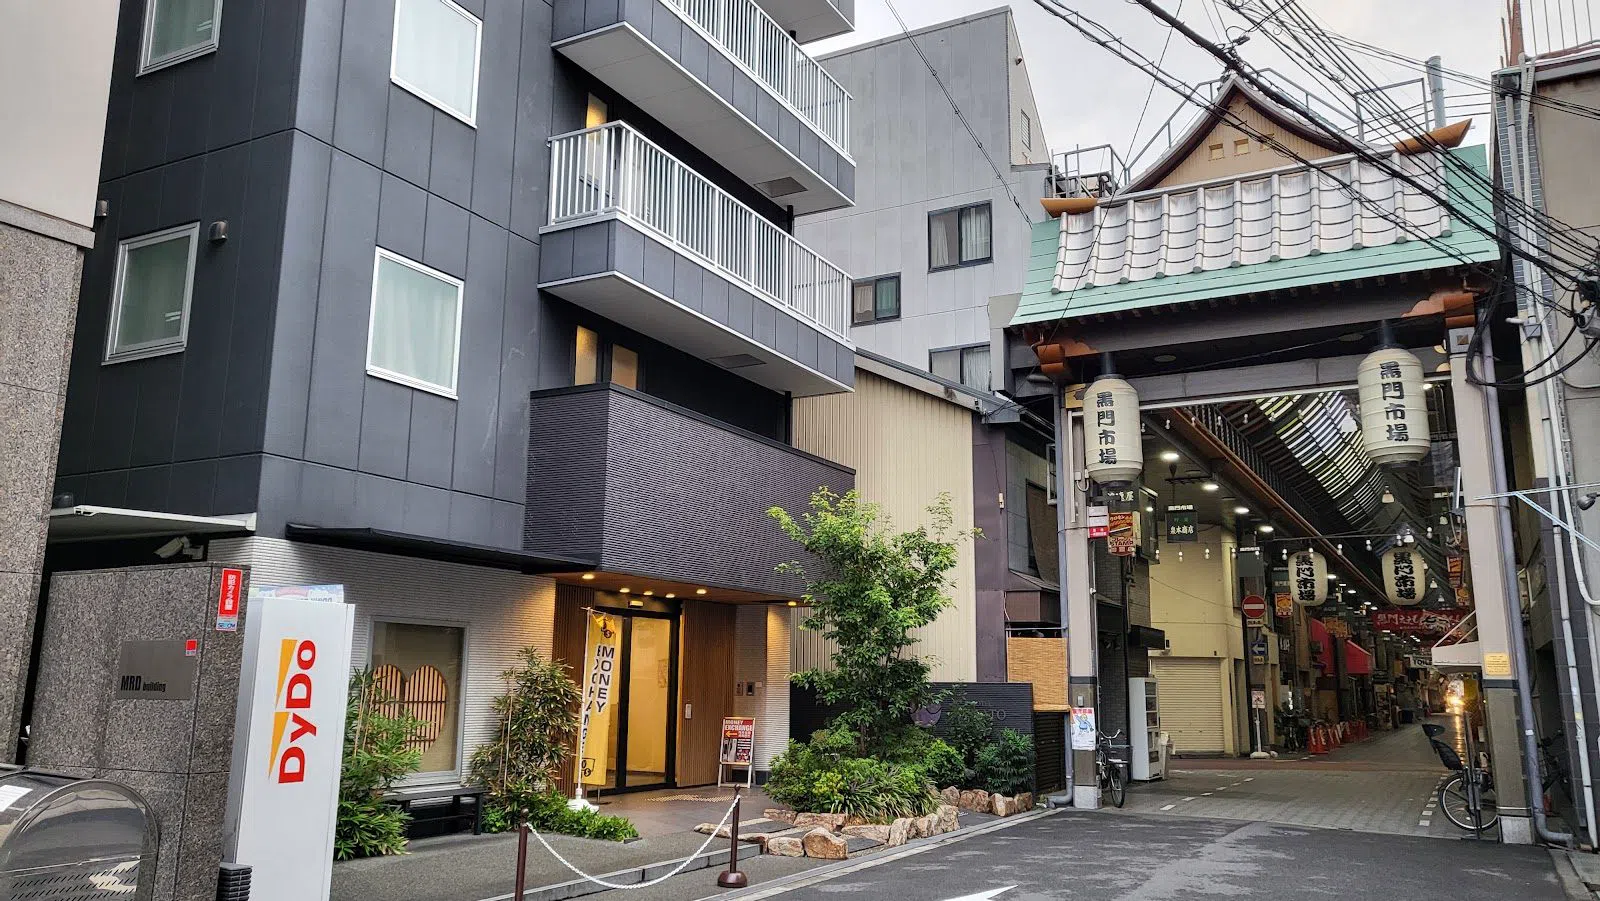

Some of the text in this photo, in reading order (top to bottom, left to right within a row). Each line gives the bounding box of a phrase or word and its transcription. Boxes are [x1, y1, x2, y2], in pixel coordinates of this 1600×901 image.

[1097, 391, 1117, 465] 黒門市場
[1380, 360, 1409, 442] 黒門市場
[1296, 555, 1316, 601] 黒門市場
[1393, 551, 1416, 599] 黒門市場
[121, 675, 167, 692] MRD building
[278, 640, 317, 784] DyDo
[596, 645, 615, 713] MONEY
